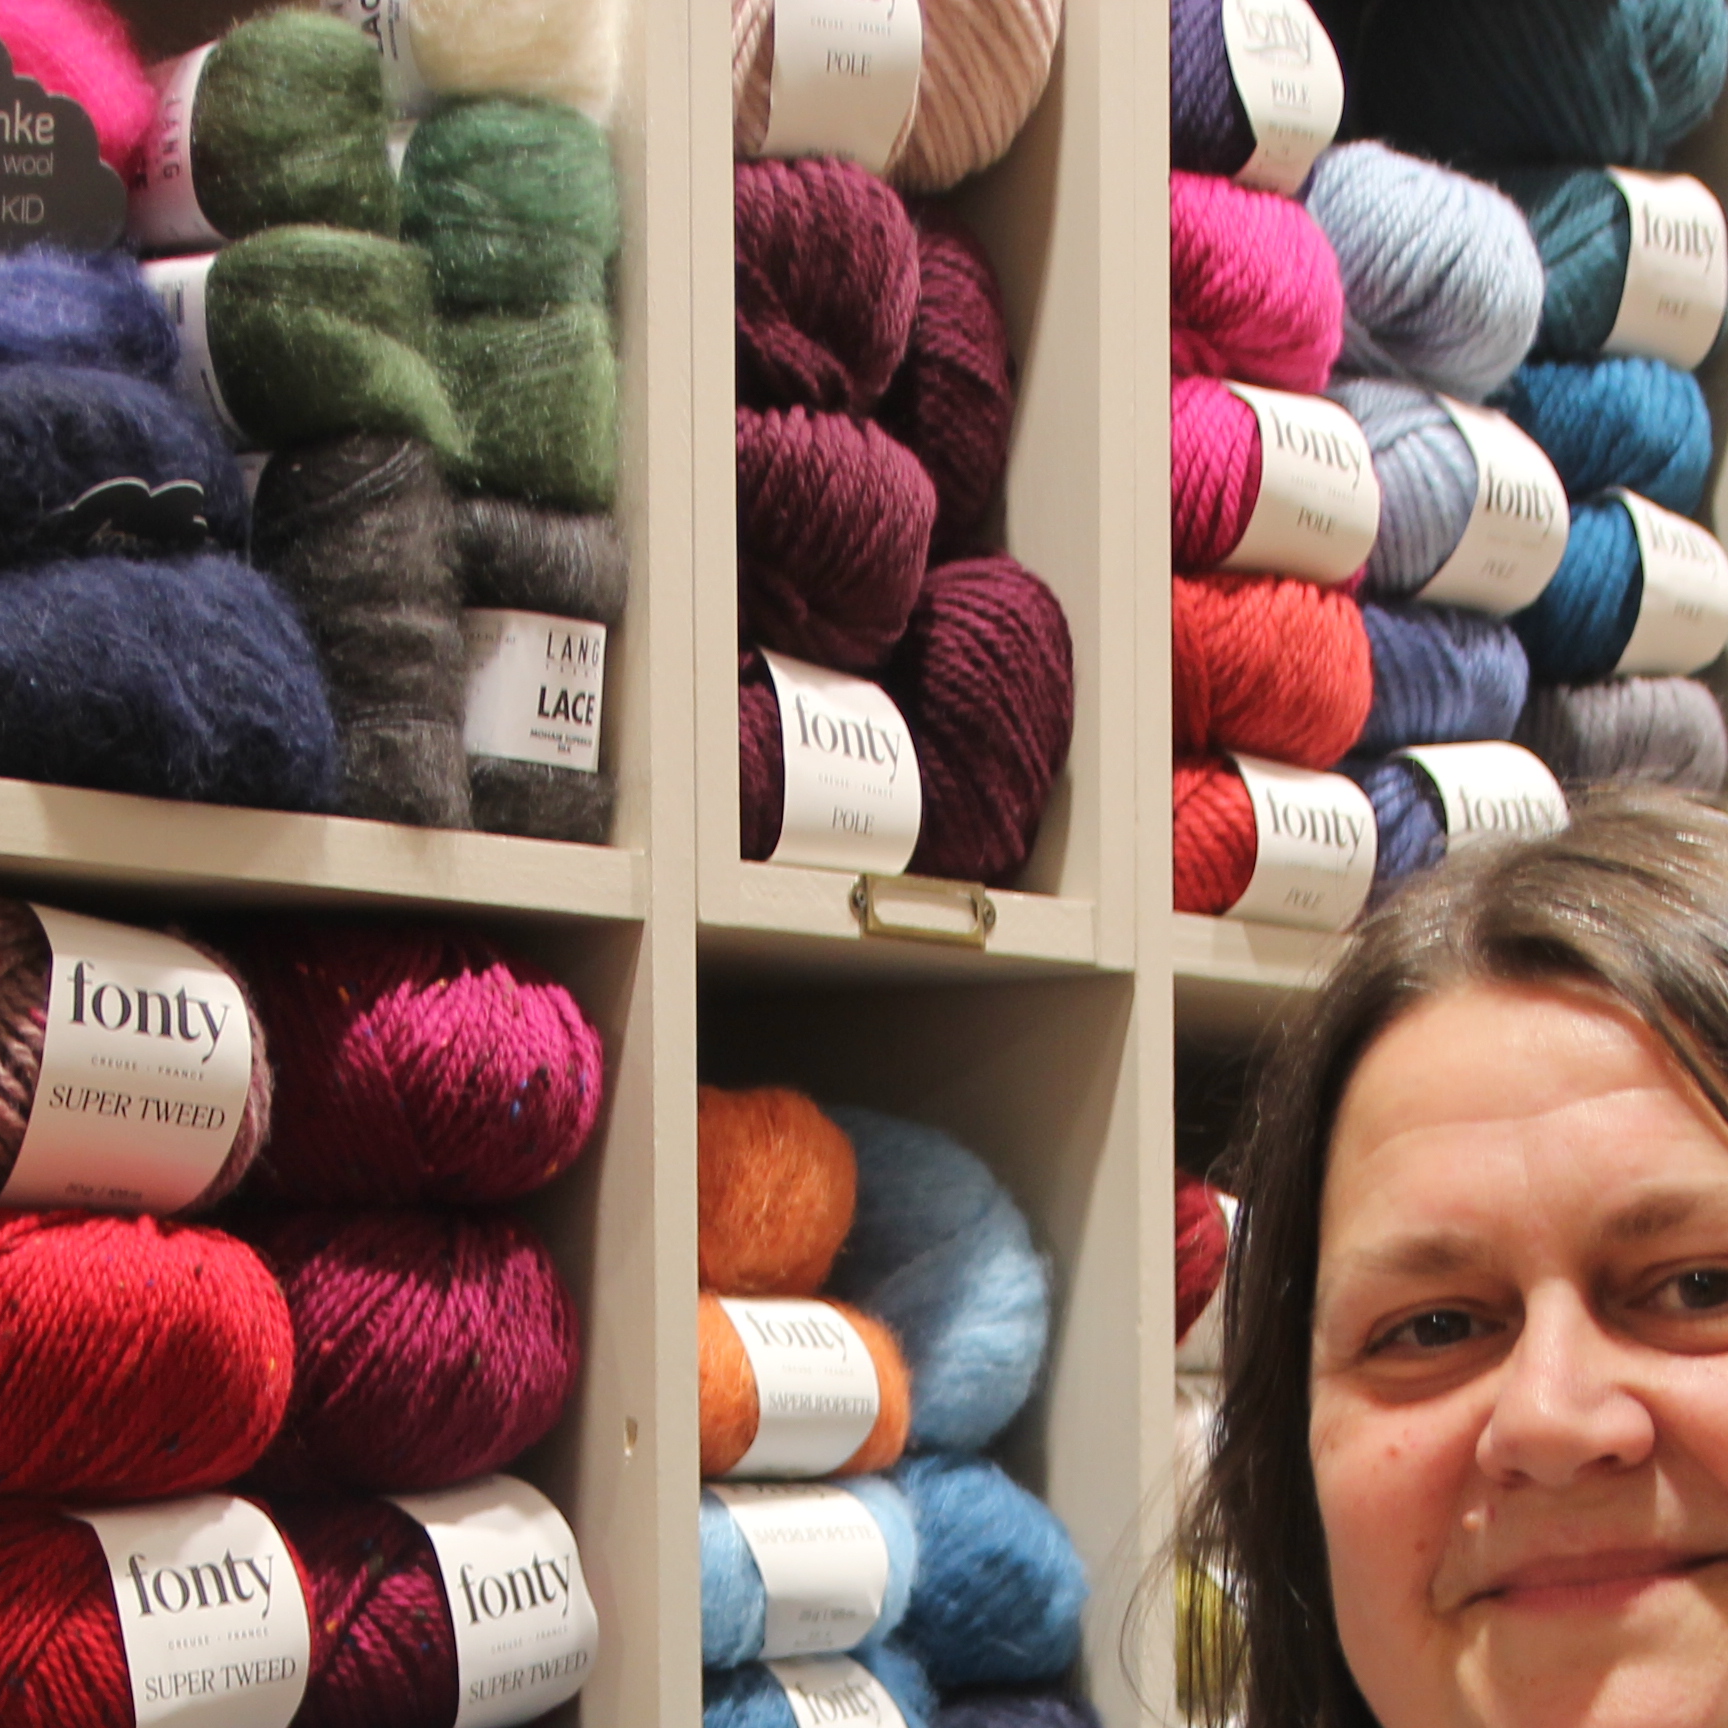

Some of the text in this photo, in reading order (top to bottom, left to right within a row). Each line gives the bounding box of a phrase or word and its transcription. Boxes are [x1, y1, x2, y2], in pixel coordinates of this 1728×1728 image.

[827, 49, 872, 77] POLE
[3, 150, 54, 177] wool
[1, 192, 45, 225] KID
[1270, 403, 1363, 489] fonty
[1296, 505, 1335, 537] POLE
[1483, 461, 1557, 537] fonty
[546, 629, 600, 666] LANG
[538, 684, 595, 726] LACE
[792, 692, 901, 784] fonty
[831, 806, 875, 835] POLE
[1267, 787, 1364, 867] fonty
[67, 960, 230, 1065] fonty
[92, 1055, 204, 1081] CREUSE FRANCE
[49, 1084, 225, 1131] SUPER TWEED
[125, 1548, 274, 1620] fonty
[457, 1550, 571, 1625] fonty
[227, 1627, 269, 1642] FRANCE
[145, 1657, 296, 1702] SUPER TWEED
[469, 1650, 589, 1705] SUPER TWEED
